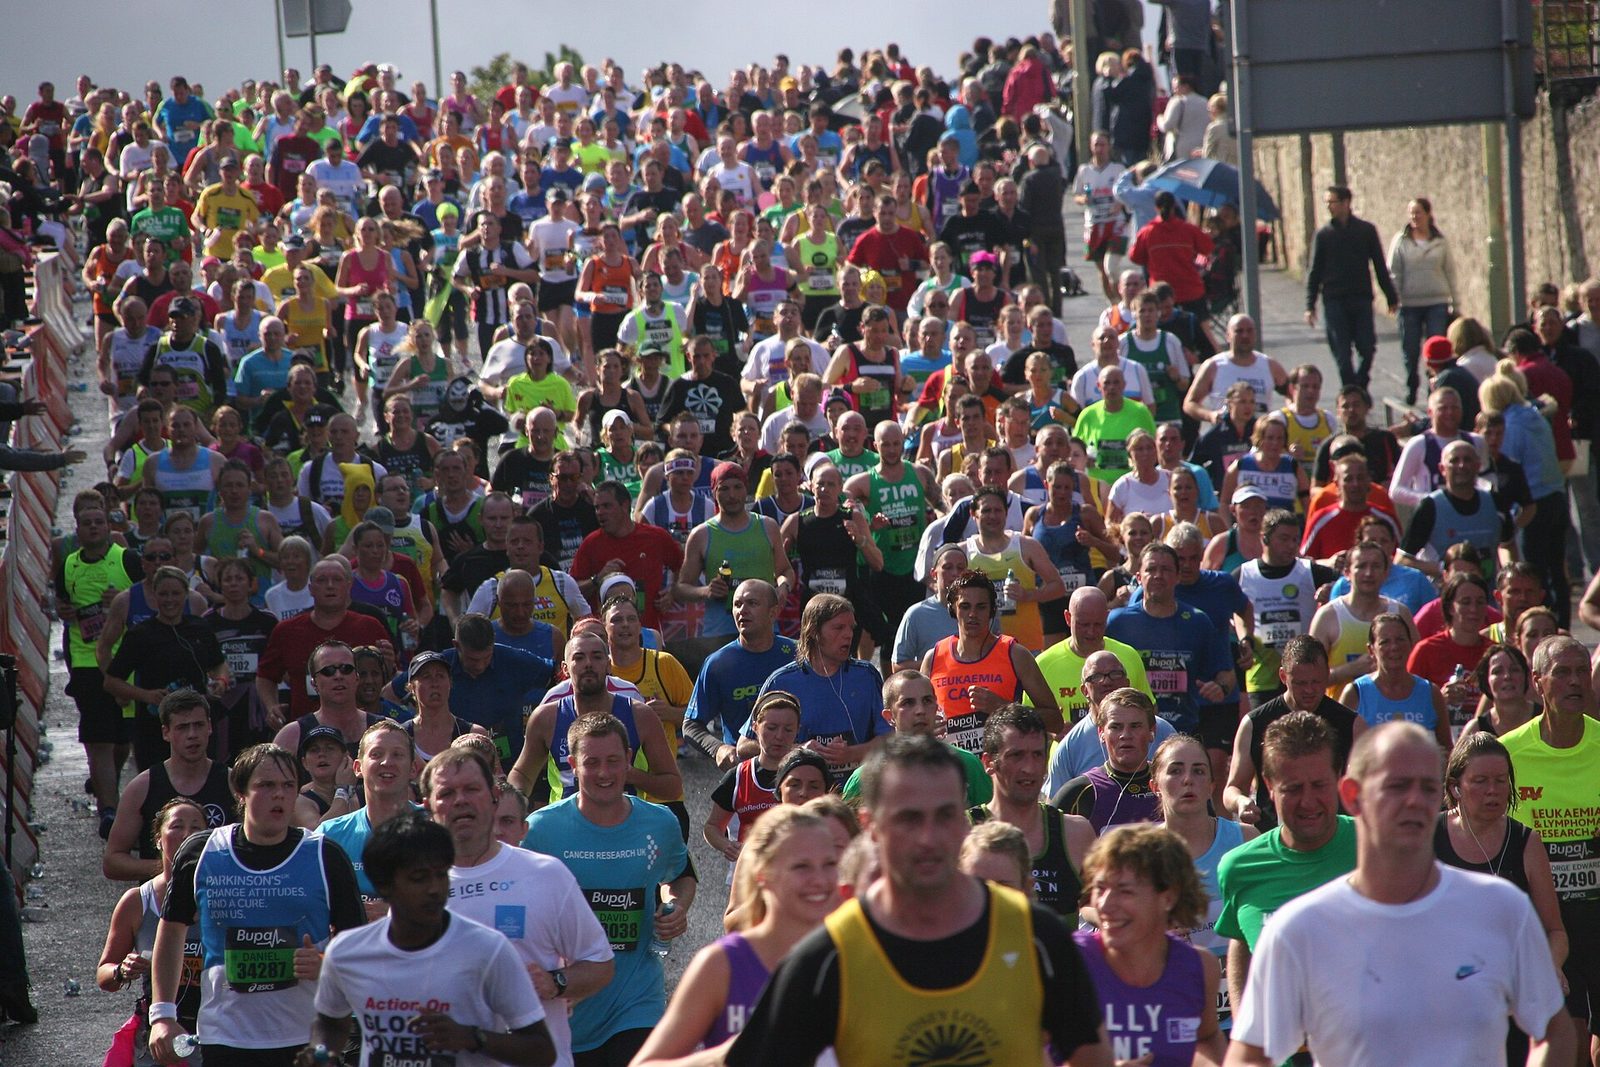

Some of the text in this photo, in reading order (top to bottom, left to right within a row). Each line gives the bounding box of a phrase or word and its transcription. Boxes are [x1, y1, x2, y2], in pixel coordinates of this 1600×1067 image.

[137, 214, 181, 229] WOLFIE
[878, 484, 918, 502] JIM
[1149, 658, 1176, 668] Bupa
[947, 716, 975, 730] Bupa
[956, 731, 979, 741] LEWIS
[1534, 820, 1542, 829] &
[563, 848, 647, 860] CANCER RESEARCH UK
[1549, 843, 1584, 858] Bupa
[206, 875, 281, 887] PARKINSON'S
[206, 887, 308, 899] CHANGE ATTITUDES.
[460, 882, 484, 896] ICE
[489, 881, 509, 892] CO
[207, 898, 268, 909] FIND A CURE.
[591, 891, 629, 907] Bupa
[210, 909, 247, 920] JOIN US.
[600, 913, 629, 923] DAVID
[236, 928, 276, 946] Bupa
[242, 951, 280, 963] DANIEL
[236, 960, 287, 980] 34287
[426, 998, 450, 1013] On
